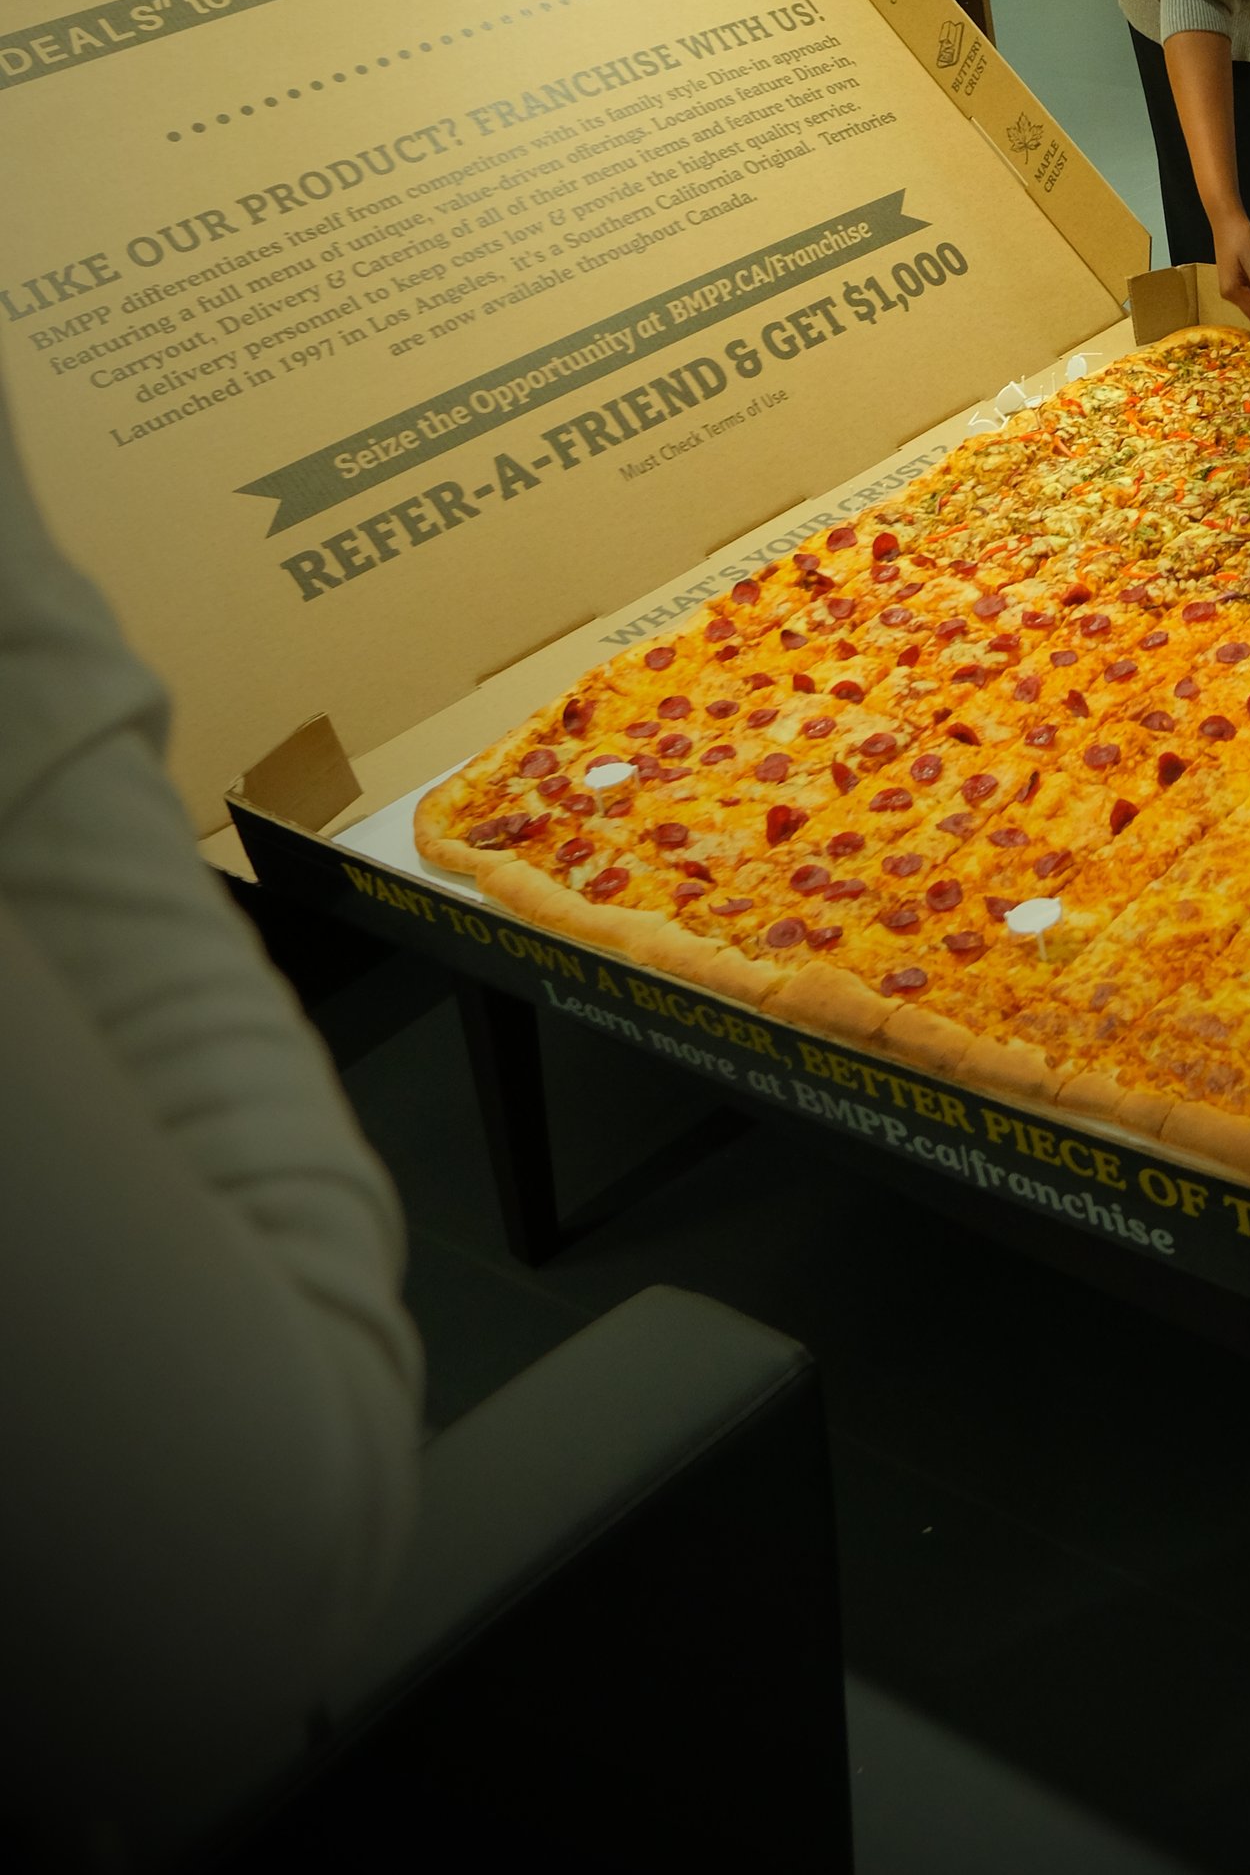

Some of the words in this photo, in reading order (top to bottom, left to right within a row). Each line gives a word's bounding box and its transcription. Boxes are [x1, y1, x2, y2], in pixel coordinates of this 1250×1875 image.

[0, 252, 123, 322] LIKE
[126, 209, 241, 268] OUR
[235, 117, 464, 226] PRODUCT?
[466, 43, 683, 137] FRANCHISE
[675, 15, 775, 61] WITH
[28, 305, 112, 351] BMPP
[121, 239, 285, 315] differentiates
[284, 211, 346, 247] itself
[346, 193, 404, 224] from
[405, 143, 531, 200] competitors
[530, 123, 580, 151] with
[578, 114, 606, 135] its
[605, 92, 665, 123] family
[666, 77, 709, 103] style
[707, 57, 772, 87] Dine-in
[772, 34, 841, 67] approach
[951, 36, 982, 93] BUTTERY
[964, 54, 988, 96] CRUST
[1034, 139, 1061, 184] MAPLE
[1043, 151, 1070, 193] CRUST
[50, 315, 178, 375] featuring
[178, 307, 195, 323] a
[197, 284, 244, 314] full
[246, 257, 318, 294] menu
[320, 241, 346, 264] of
[346, 211, 436, 253] unique,
[434, 158, 565, 216] value-driven
[566, 126, 652, 165] offerings.
[651, 94, 736, 131] Locations
[735, 74, 794, 102] feature
[793, 53, 857, 82] Dine-in,
[90, 330, 217, 390] Carryout,
[216, 283, 322, 336] Delivery
[325, 269, 348, 290] &
[351, 229, 451, 278] Catering
[451, 217, 474, 239] of
[477, 207, 504, 230] all
[507, 195, 531, 217] of
[529, 178, 580, 207] their
[583, 156, 638, 186] menu
[636, 136, 691, 164] items
[692, 121, 727, 144] and
[726, 101, 786, 130] feature
[785, 86, 825, 110] their
[827, 76, 861, 95] own
[109, 377, 245, 448] Launched
[244, 366, 277, 389] in
[278, 337, 337, 374] 1997
[338, 327, 370, 348] in
[367, 307, 411, 334] Los
[414, 269, 507, 315] Angeles,
[510, 248, 547, 273] it's
[550, 242, 565, 258] a
[563, 204, 657, 250] Southern
[655, 168, 745, 211] California
[743, 139, 817, 175] Original.
[818, 109, 898, 147] Territories
[135, 349, 239, 404] delivery
[243, 295, 363, 361] personnel
[364, 287, 392, 306] to
[391, 262, 448, 294] keep
[451, 239, 506, 269] costs
[504, 220, 545, 246] low
[548, 208, 568, 228] &
[571, 180, 647, 222] provide
[646, 161, 683, 188] the
[678, 141, 746, 171] highest
[745, 119, 803, 151] quality
[803, 99, 862, 128] service.
[333, 427, 421, 479] Seize
[417, 403, 473, 440] the
[468, 327, 637, 416] Opportunity
[635, 310, 667, 340] at
[665, 220, 875, 325] BMPP.CA/Franchise
[388, 332, 428, 358] are
[427, 307, 478, 340] now
[482, 264, 577, 316] available
[576, 219, 687, 274] throughout
[685, 189, 759, 227] Canada.
[280, 356, 728, 603] REFER-A-FRIEND
[724, 337, 764, 380] &
[760, 294, 848, 361] GET
[842, 241, 970, 326] $1,000
[617, 453, 658, 483] Must
[659, 431, 705, 462] Check
[702, 408, 746, 441] Terms
[746, 397, 761, 418] of
[760, 386, 790, 410] Use
[599, 563, 750, 647] WHAT'S
[738, 508, 848, 567] YOUR
[340, 862, 437, 923] WANT
[440, 902, 492, 945] TO
[497, 927, 587, 984] OWN
[597, 965, 624, 999] A
[627, 975, 795, 1072] BIGGER,
[798, 1039, 976, 1135] BETTER
[980, 1107, 1127, 1192] PIECE
[1138, 1168, 1210, 1218] OF
[541, 978, 644, 1042] Learn
[647, 1026, 738, 1082] more
[746, 1070, 789, 1101] at
[790, 1079, 1177, 1256] BMPP.ca/franchise
